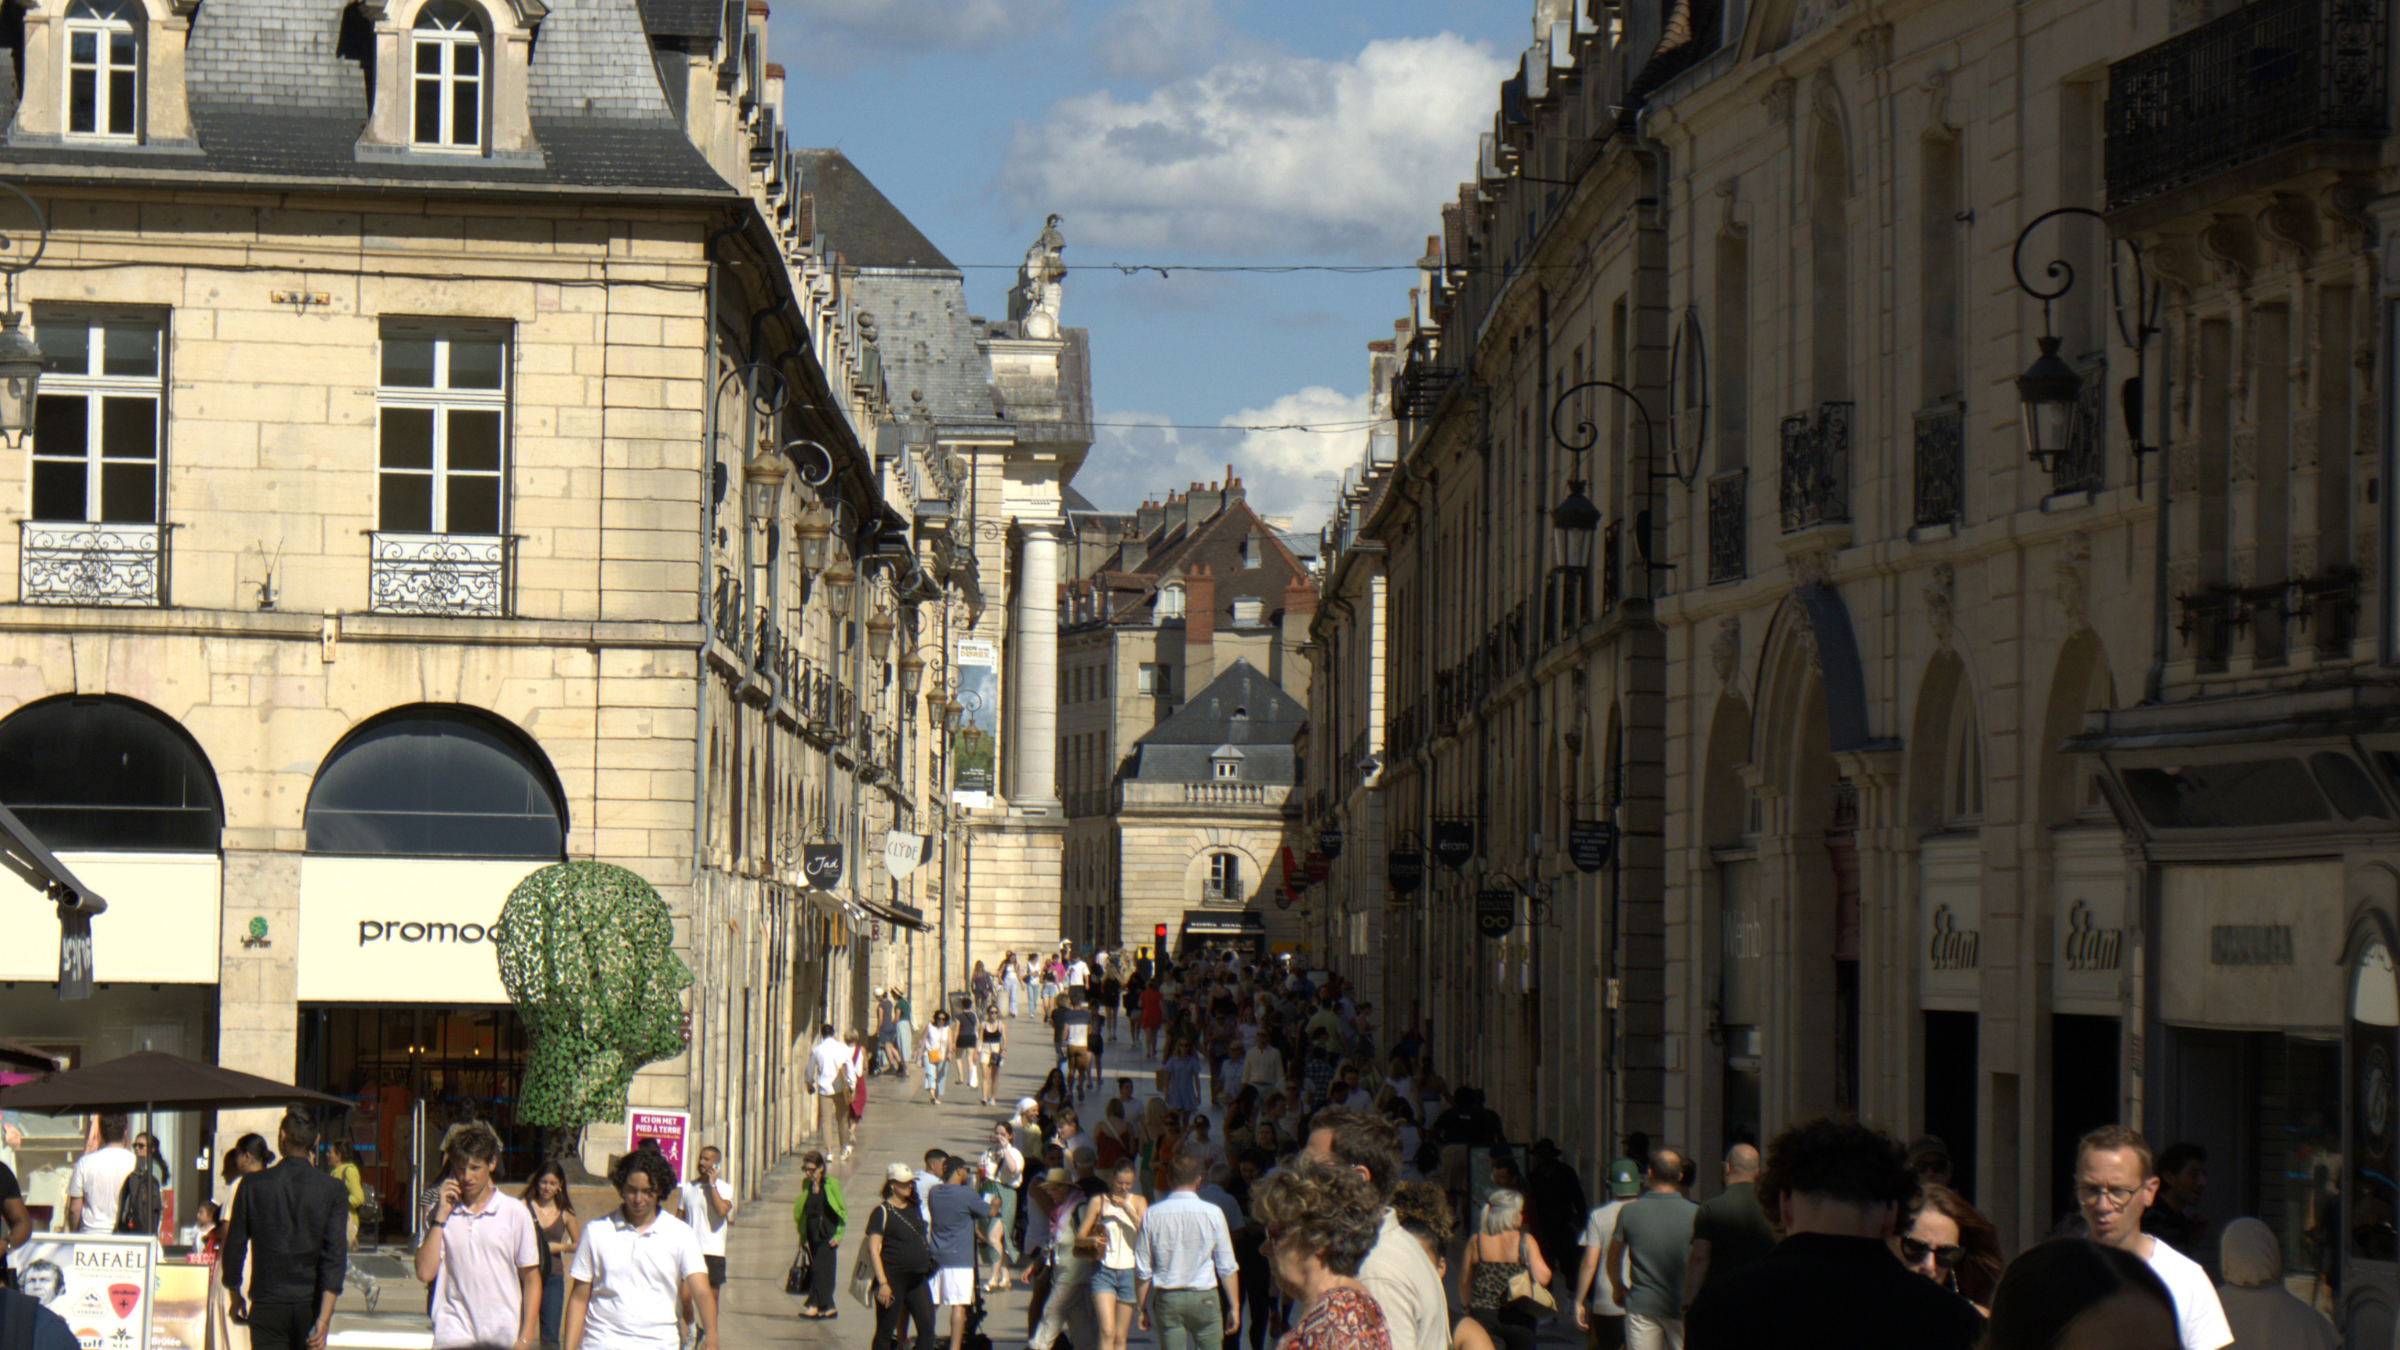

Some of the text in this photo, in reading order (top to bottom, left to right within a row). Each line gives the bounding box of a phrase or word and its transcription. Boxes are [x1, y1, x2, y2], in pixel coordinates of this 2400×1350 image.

[1439, 839, 1469, 851] éram
[1930, 904, 1979, 970] Etam
[2065, 900, 2121, 970] Etam
[641, 1115, 677, 1125] ICI ON MET
[635, 1124, 681, 1135] PIED À TERRE
[75, 1251, 145, 1268] RAFAËL
[151, 1337, 181, 1347] Brûlée
